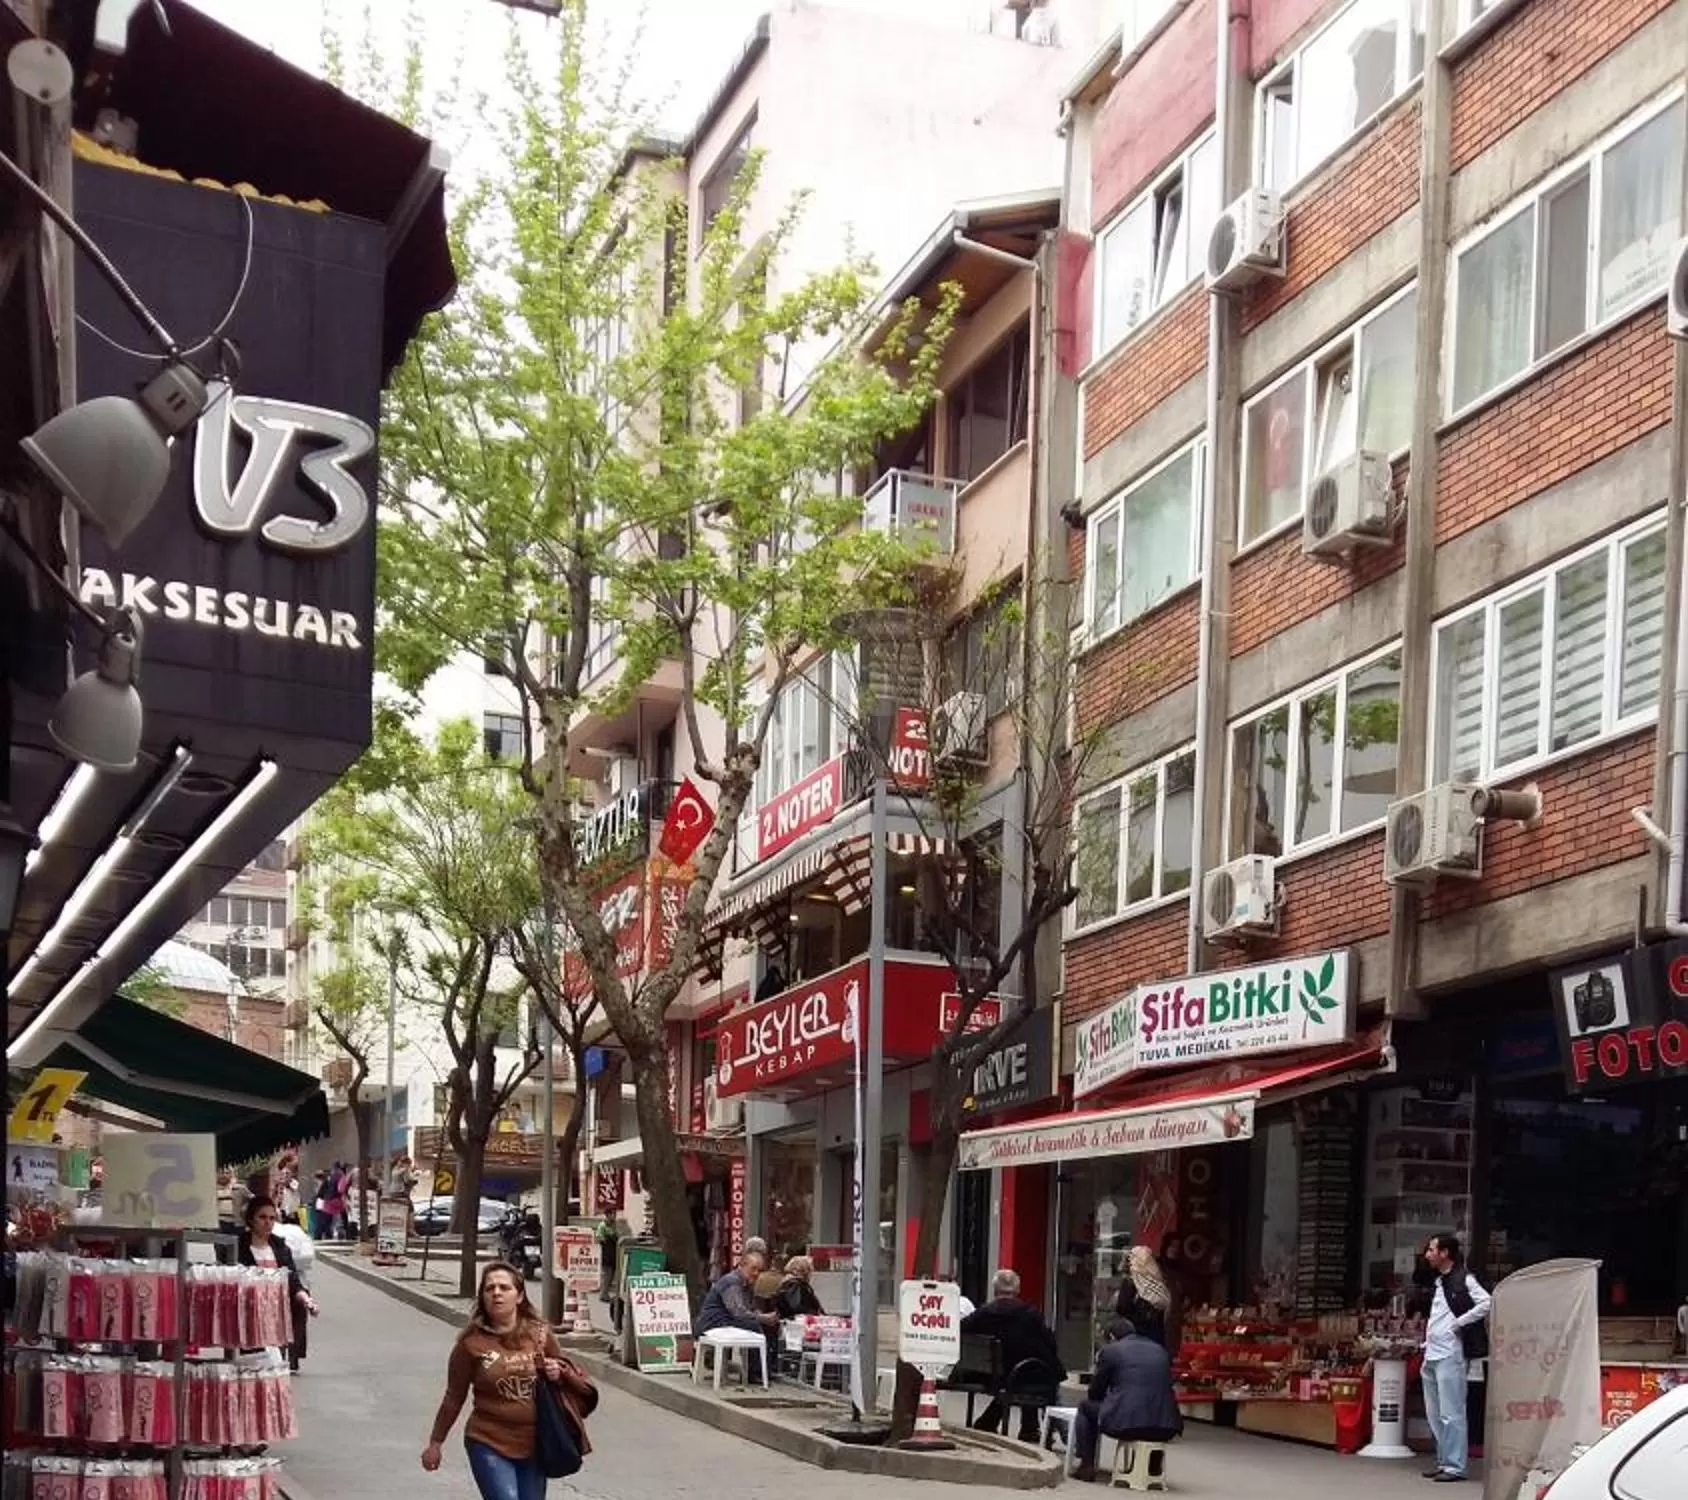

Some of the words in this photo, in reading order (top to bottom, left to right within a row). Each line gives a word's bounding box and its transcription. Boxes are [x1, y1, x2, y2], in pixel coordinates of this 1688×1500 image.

[81, 566, 363, 650] AKSESUAR
[734, 992, 840, 1067] BEYLER
[755, 1046, 816, 1077] KEBAP
[1140, 1048, 1171, 1061] TUVA
[1175, 1038, 1233, 1058] MEDİKAL
[1572, 1020, 1688, 1084] FOTO
